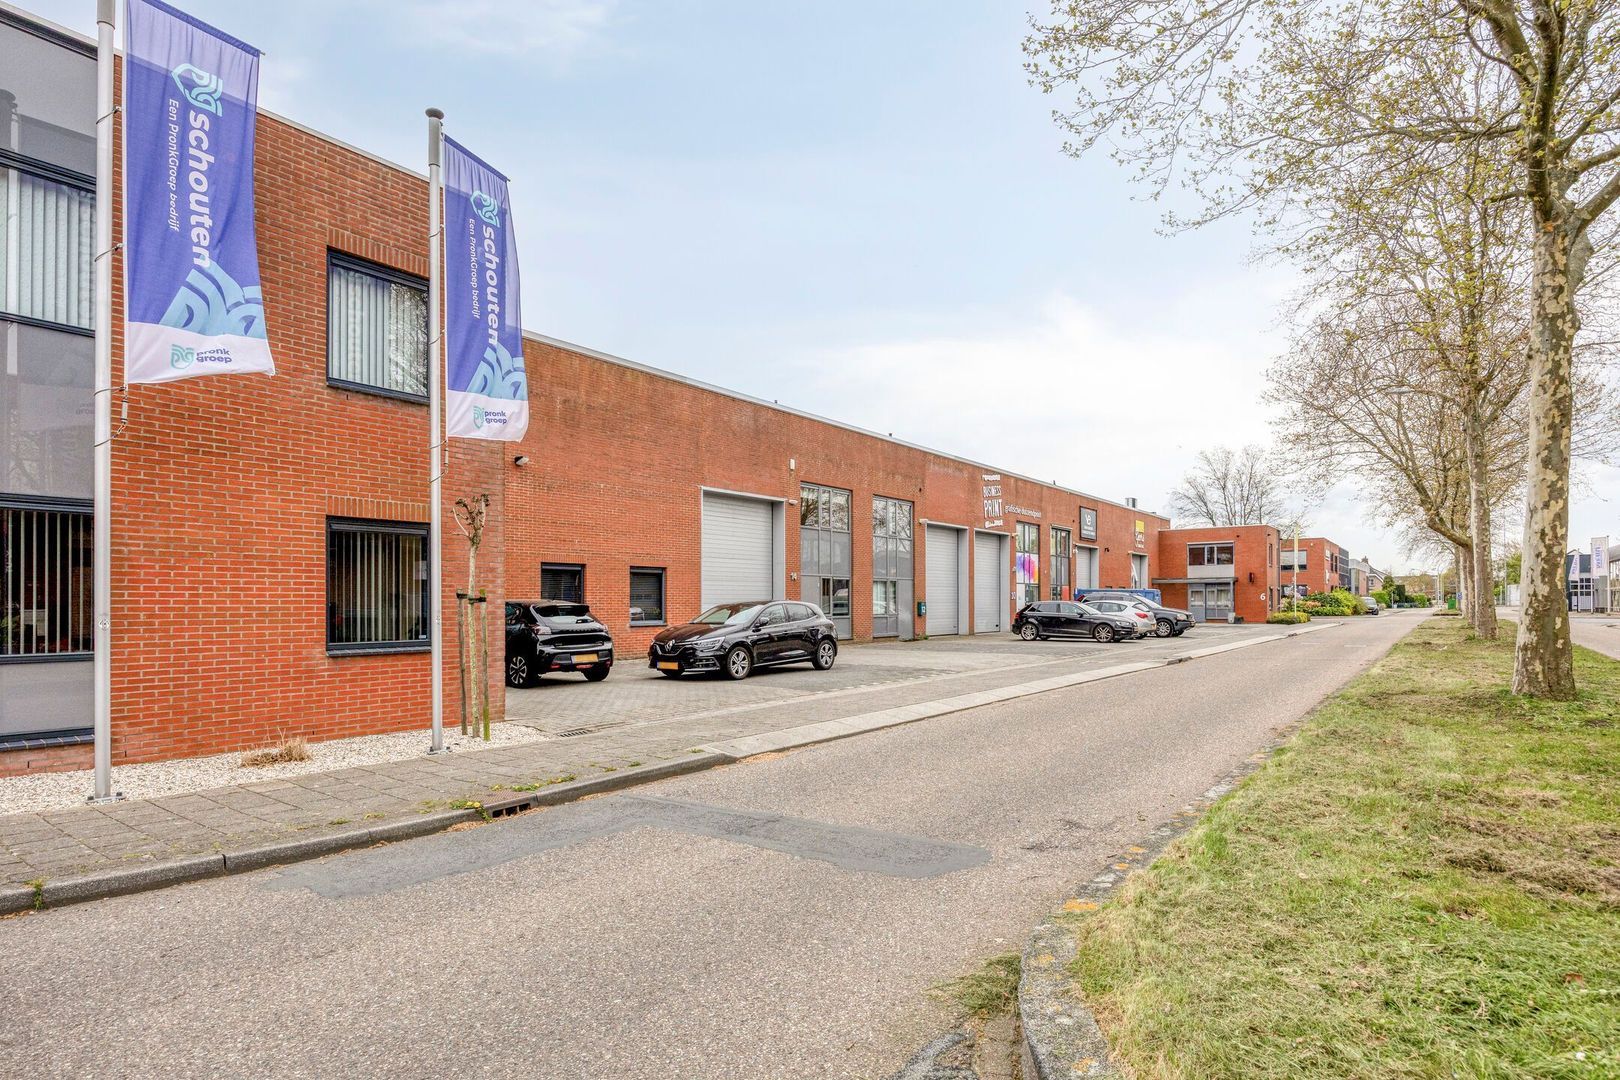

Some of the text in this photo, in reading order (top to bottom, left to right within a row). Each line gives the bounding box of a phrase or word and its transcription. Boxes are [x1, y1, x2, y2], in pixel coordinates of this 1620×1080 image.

[167, 99, 180, 232] Een PronkGroep bedrijf
[188, 110, 215, 268] schouten
[469, 236, 479, 288] PronkGroep
[482, 225, 500, 345] schouten
[471, 288, 481, 319] bedrijf
[196, 348, 231, 357] pronk
[196, 356, 233, 364] groep
[485, 417, 507, 425] groep
[984, 499, 1003, 519] PRINT
[1260, 592, 1266, 600] 6
